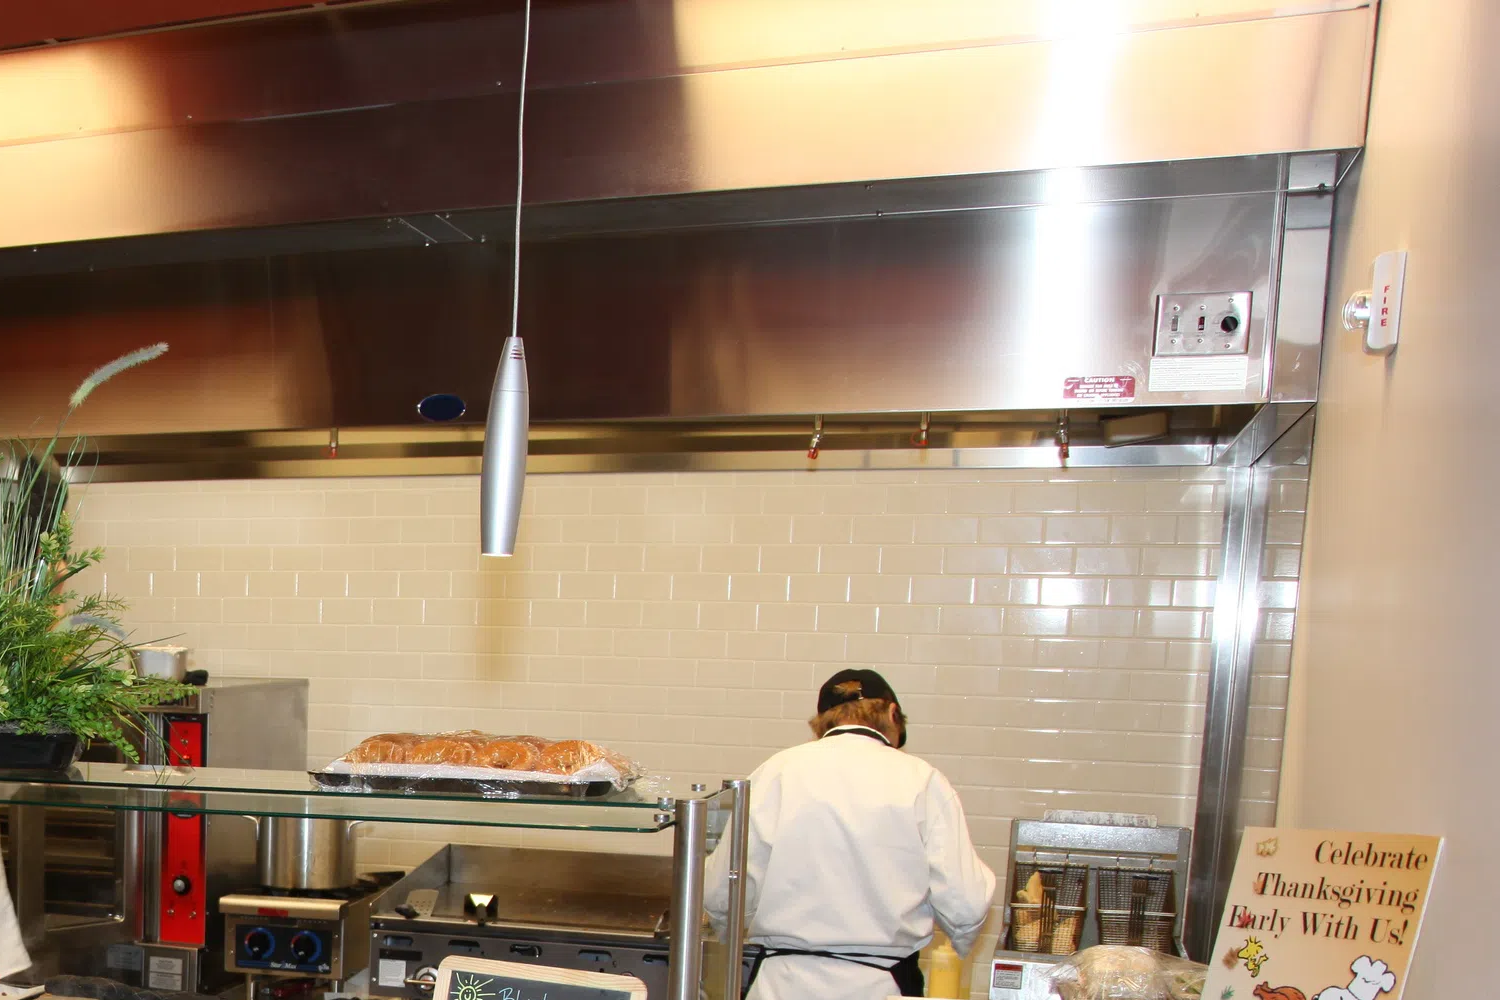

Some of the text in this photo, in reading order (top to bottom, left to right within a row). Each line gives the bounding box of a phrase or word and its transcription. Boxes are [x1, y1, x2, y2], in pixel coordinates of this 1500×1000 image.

[1380, 285, 1390, 327] FIRE
[1315, 839, 1428, 871] Celebrate
[1257, 871, 1419, 916] Thanksgiving
[1227, 904, 1409, 945] Early With Us!
